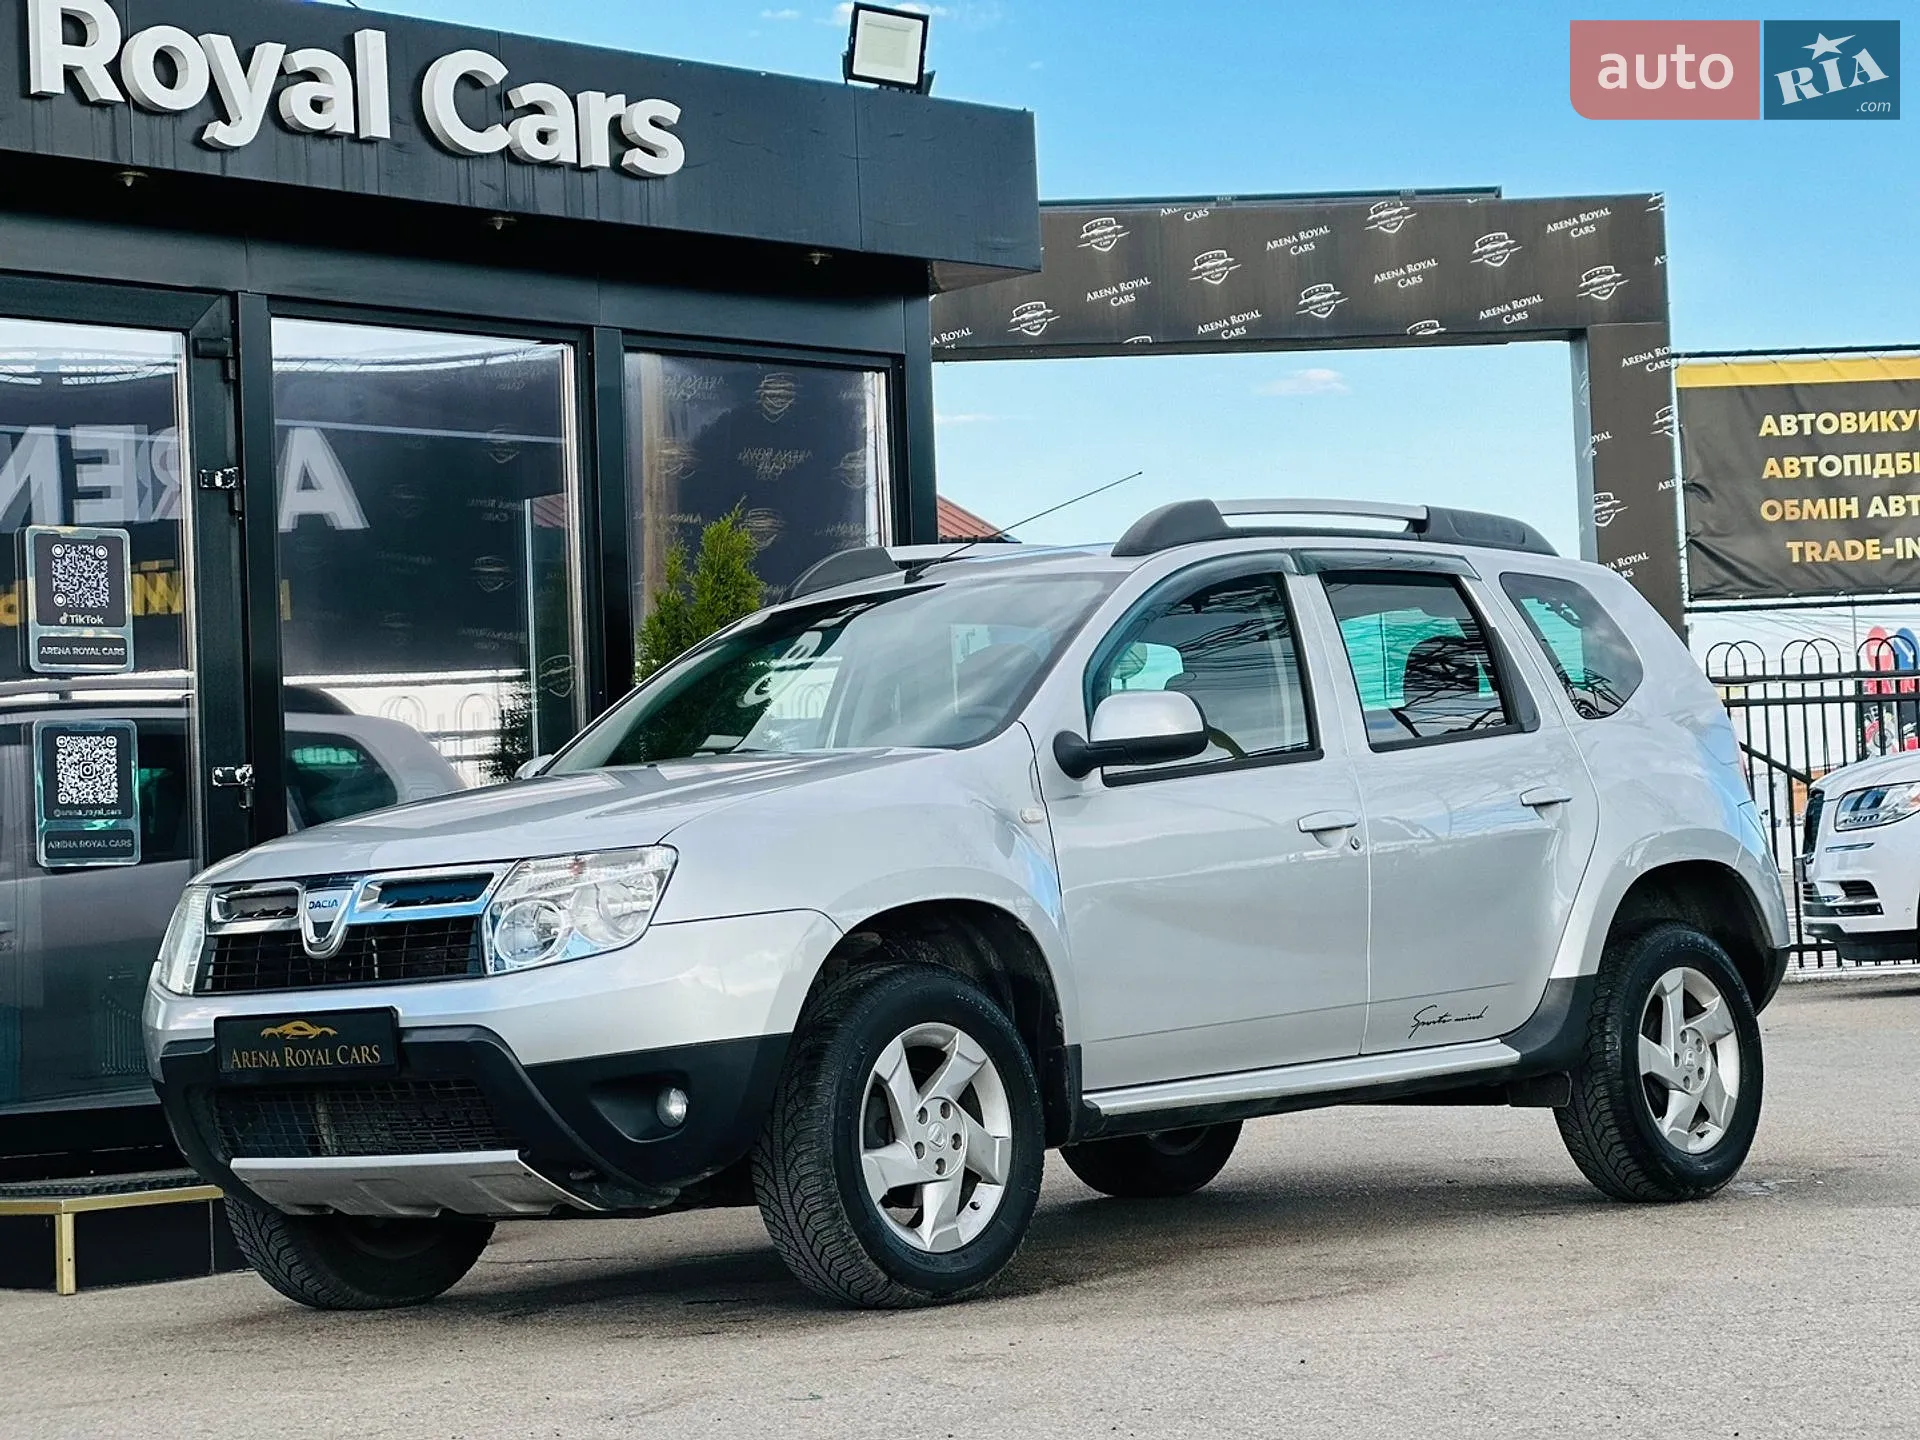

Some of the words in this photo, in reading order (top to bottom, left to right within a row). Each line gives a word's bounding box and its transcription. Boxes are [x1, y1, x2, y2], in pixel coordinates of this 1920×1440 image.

[28, 0, 390, 151] Royal
[422, 49, 685, 177] Cars
[1546, 217, 1579, 233] ARENA
[1579, 207, 1612, 223] ROYAL
[1266, 235, 1298, 251] ARENA
[1299, 225, 1330, 240] ROYAL
[1570, 224, 1596, 238] CARS
[1290, 241, 1316, 255] CARS
[1373, 268, 1406, 284] ARENA
[1406, 258, 1439, 274] ROYAL
[1086, 286, 1118, 302] ARENA
[1119, 276, 1152, 292] ROYAL
[1397, 274, 1423, 288] CARS
[1110, 292, 1136, 307] CARS
[1479, 303, 1510, 320] ARENA
[1511, 294, 1544, 309] ROYAL
[1197, 319, 1230, 335] ARENA
[1230, 309, 1263, 325] ROYAL
[1502, 310, 1529, 324] CARS
[940, 327, 974, 343] ROYAL
[1221, 325, 1247, 339] CARS
[1621, 351, 1654, 368] ARENA
[1759, 409, 1920, 437] АВТОВИКУ
[1760, 496, 1859, 522] ОБМІН
[1786, 536, 1920, 563] TRADE-IN
[1617, 551, 1650, 568] ROYAL
[70, 613, 104, 625] TikTok
[40, 646, 71, 655] ARENA
[72, 647, 101, 656] ROYAL
[101, 647, 126, 656] CARS
[79, 840, 108, 849] ROYAL
[108, 839, 133, 849] CARS
[308, 898, 339, 911] DACIA
[231, 1049, 280, 1069] ARENA
[283, 1045, 334, 1068] ROYAL
[336, 1043, 381, 1065] CARS
